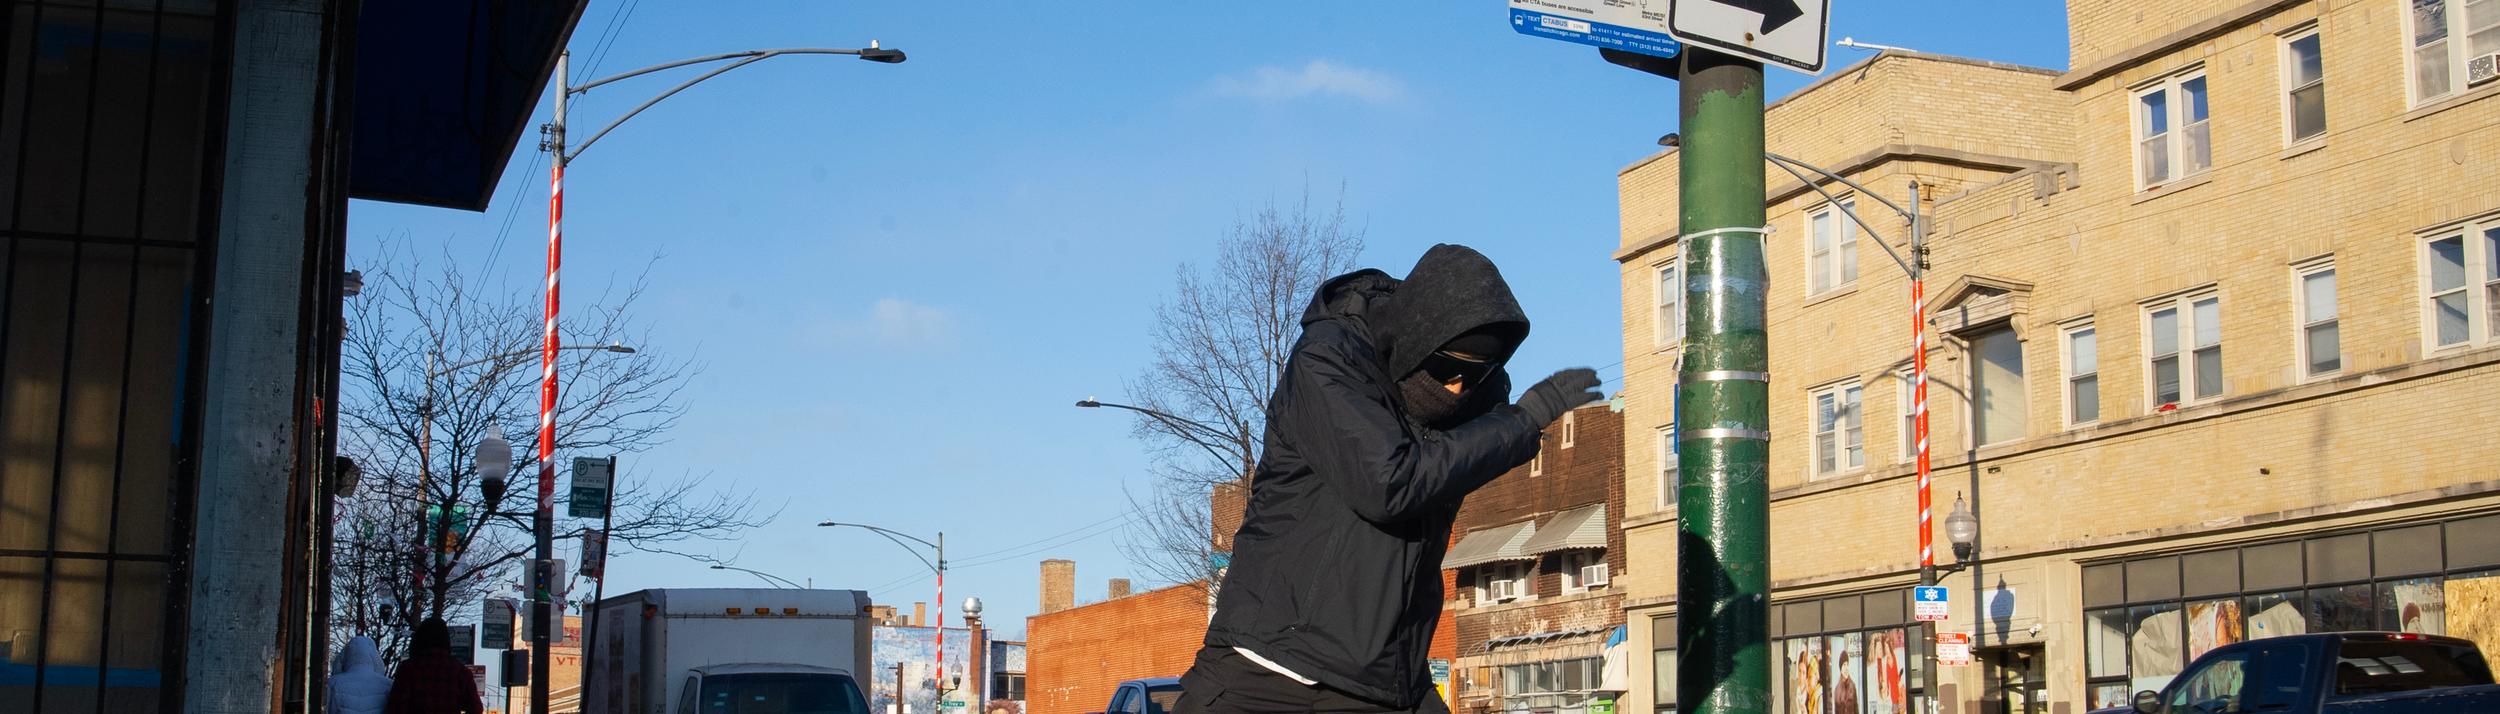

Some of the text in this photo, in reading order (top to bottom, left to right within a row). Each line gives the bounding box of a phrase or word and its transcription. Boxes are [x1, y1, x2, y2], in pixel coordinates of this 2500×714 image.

[1541, 1, 1557, 9] buses
[1567, 6, 1594, 14] accessible
[1542, 17, 1568, 27] CTABUS
[1621, 32, 1645, 41] estimated
